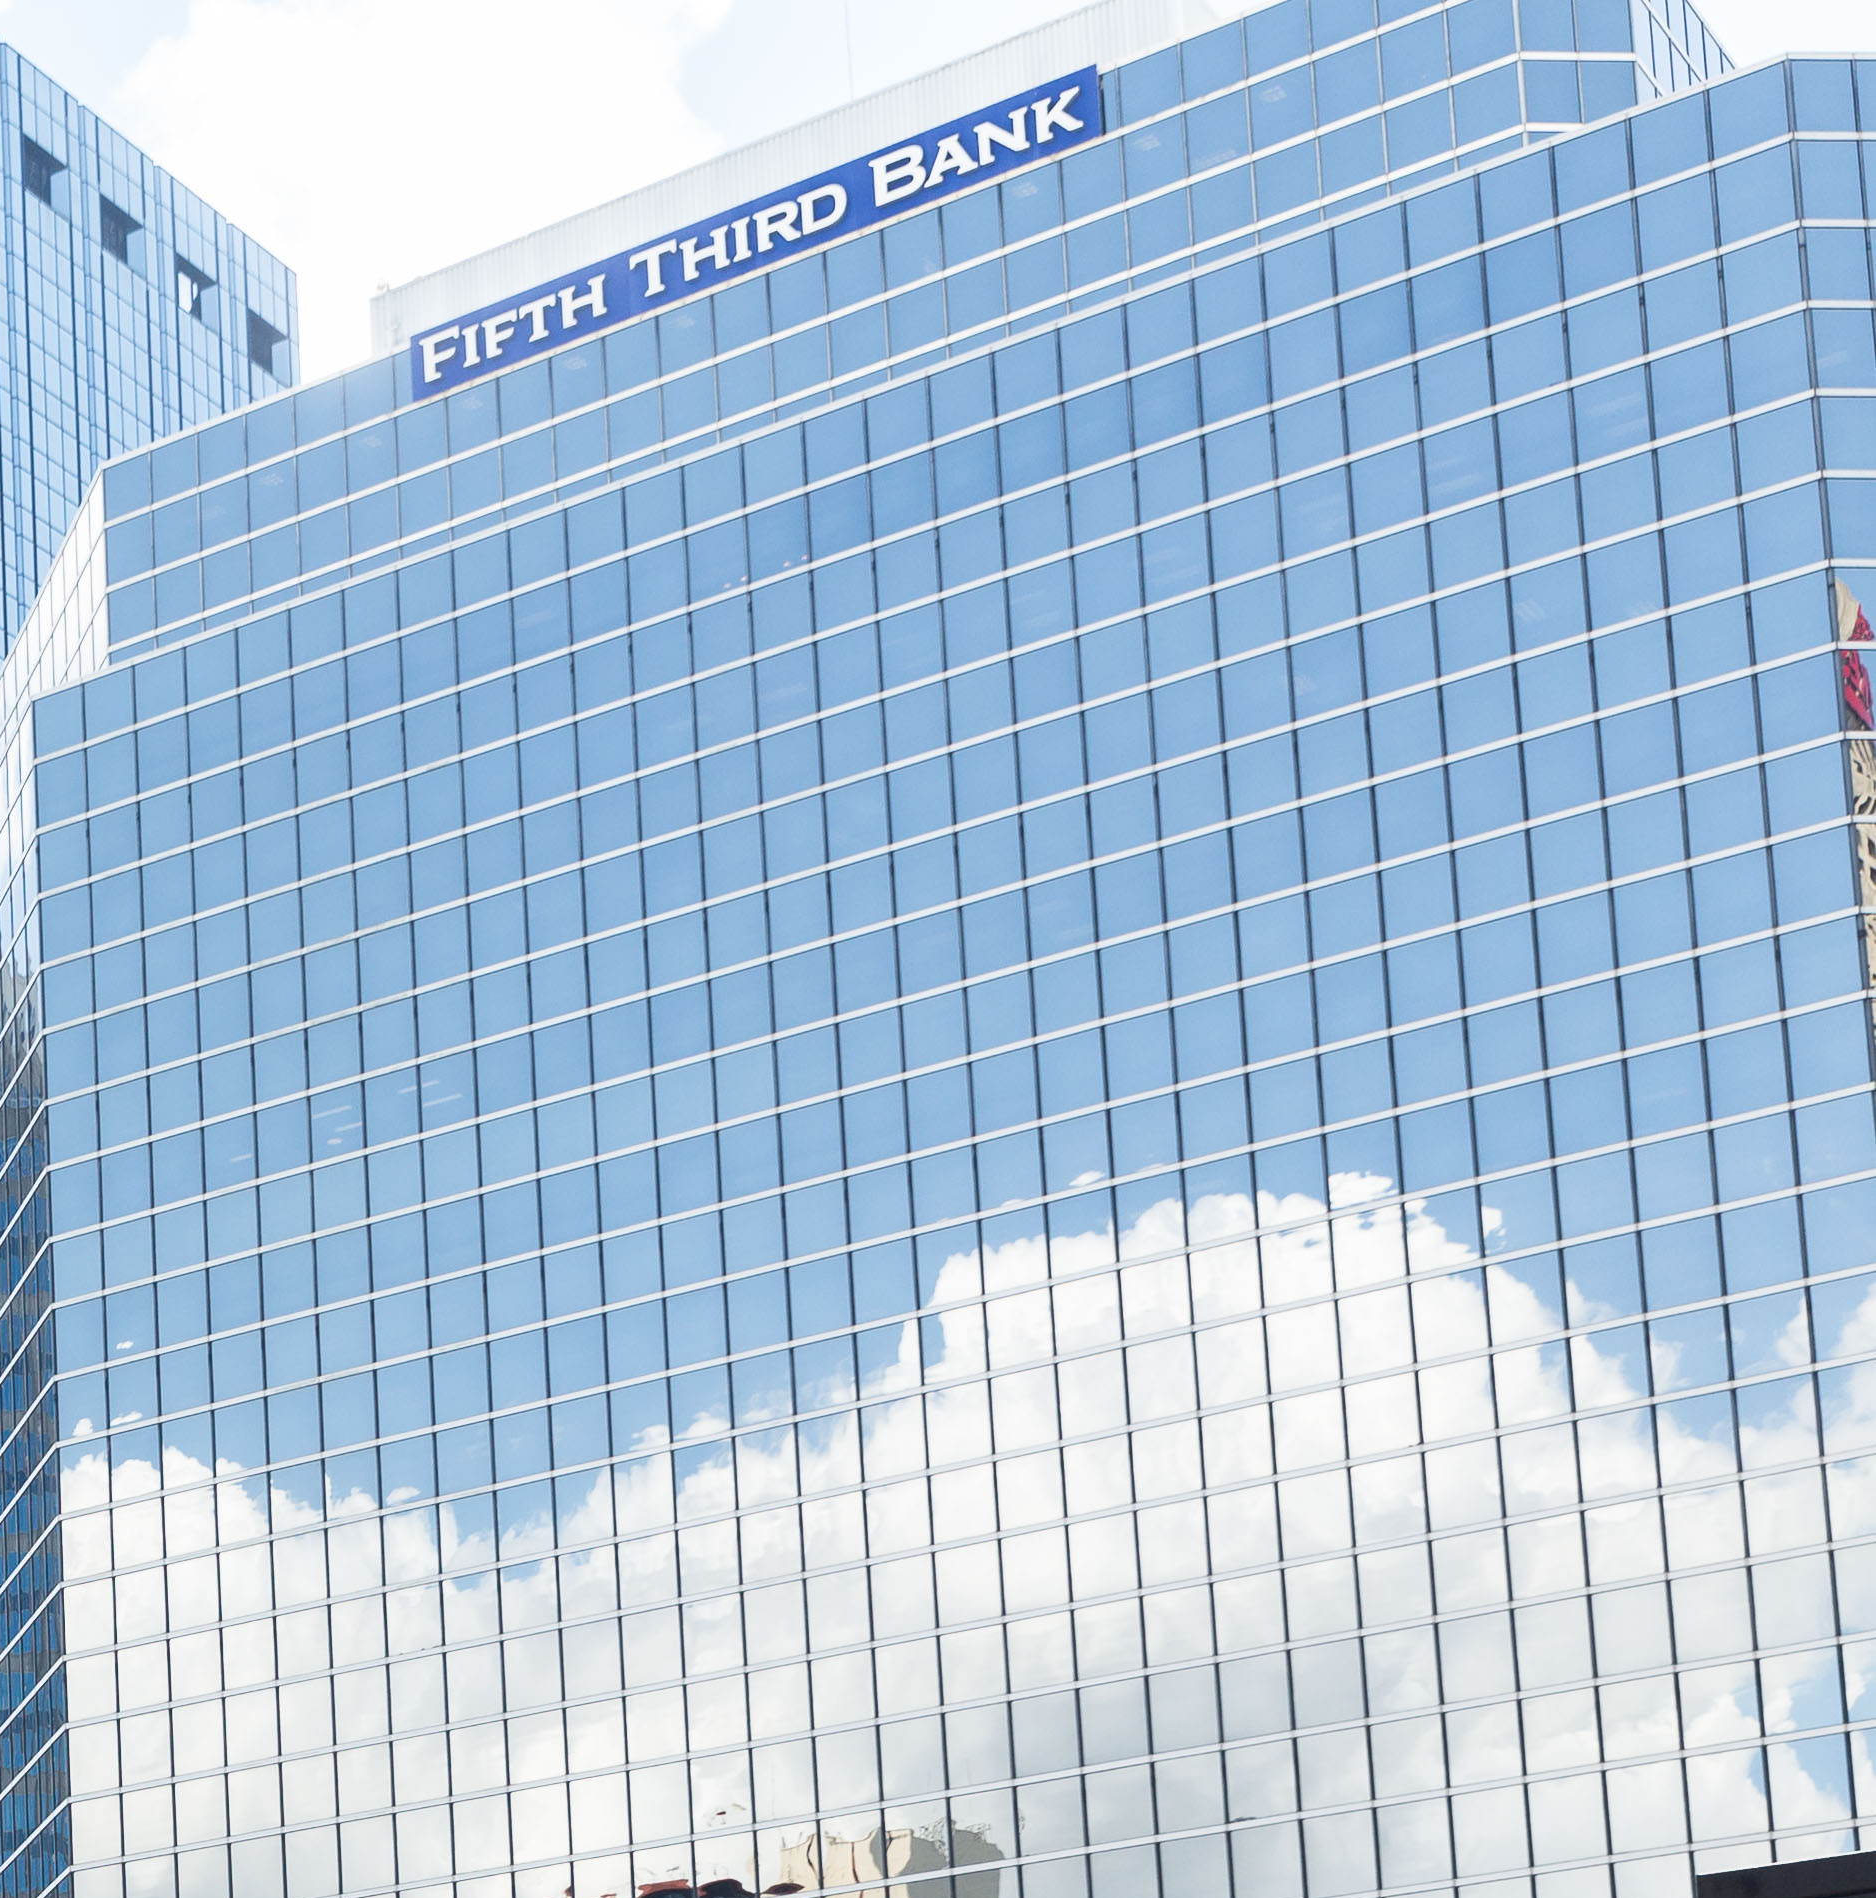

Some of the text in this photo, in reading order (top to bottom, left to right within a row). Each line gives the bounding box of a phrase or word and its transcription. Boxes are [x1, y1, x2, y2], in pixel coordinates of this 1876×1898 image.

[418, 84, 1085, 384] FIFTH THIRD BANK
